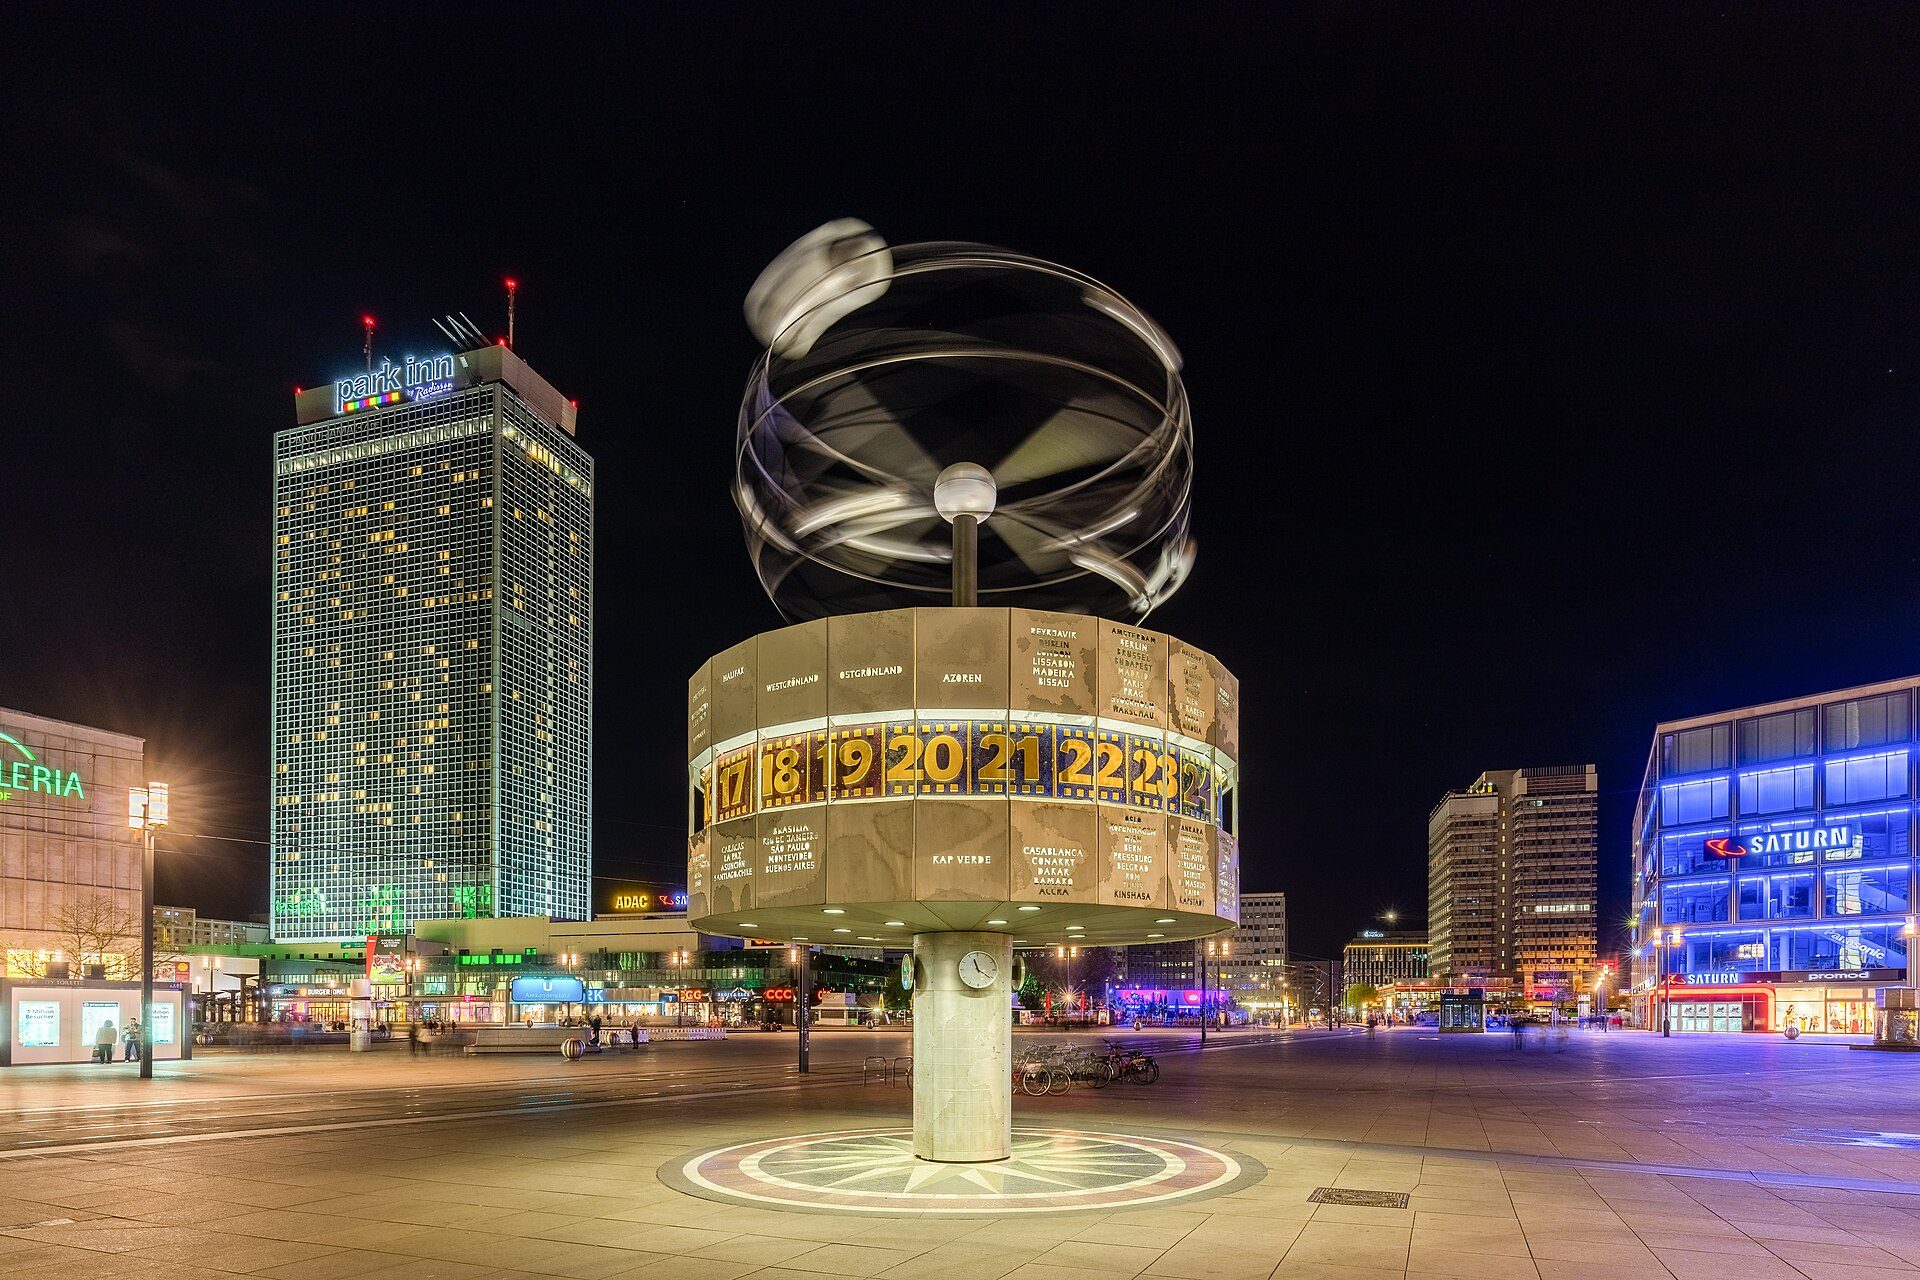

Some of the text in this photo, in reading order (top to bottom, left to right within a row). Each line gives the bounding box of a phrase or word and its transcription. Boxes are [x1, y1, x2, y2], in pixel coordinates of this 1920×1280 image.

[336, 355, 454, 413] park inn
[415, 382, 453, 401] Radisson
[1111, 627, 1156, 644] AMSTERDAM
[1120, 638, 1148, 652] BERLIN
[1032, 657, 1075, 669] LISSABON
[1114, 657, 1152, 672] BUDAPEST
[839, 665, 903, 679] OSTGRÖNLAND
[943, 673, 982, 683] AZOREN
[1032, 667, 1075, 678] MADEIRA
[1118, 667, 1148, 680] MADRID
[766, 674, 819, 692] WESTGRÖNLAND
[1038, 677, 1069, 687] BISSAU
[1123, 678, 1144, 689] PARIS
[1123, 687, 1144, 698] PRAG
[1111, 696, 1155, 710] STOCKHOLM
[1113, 704, 1154, 719] WARSCHAU
[817, 738, 873, 788] 19
[886, 734, 964, 783] 20
[978, 733, 1040, 781] 21
[1058, 738, 1124, 789] 22
[761, 748, 800, 798] 18
[1132, 749, 1179, 799] 23
[720, 760, 748, 809] 17
[1751, 827, 1847, 853] SATURN
[787, 842, 810, 852] PAULO
[1023, 846, 1083, 857] CASABLANCA
[1123, 844, 1142, 852] BERN
[723, 852, 742, 862] LA PAZ
[768, 851, 813, 863] MONTEVIDEO
[932, 855, 991, 865] KAP VERDE
[1031, 857, 1076, 867] CONAKRY
[1113, 851, 1153, 864] PRESSBURG
[765, 861, 815, 873] BUENOS AIRES
[1037, 867, 1070, 876] DAKAR
[1117, 862, 1149, 872] BELGRAD
[1114, 890, 1151, 900] KINSHASA
[615, 895, 648, 909] ADAC
[1823, 929, 1885, 960] Panasonic
[1687, 973, 1739, 984] SATURN
[1808, 971, 1870, 981] promod
[307, 988, 331, 996] BURGER
[543, 981, 553, 991] U
[766, 989, 792, 1000] CCC
